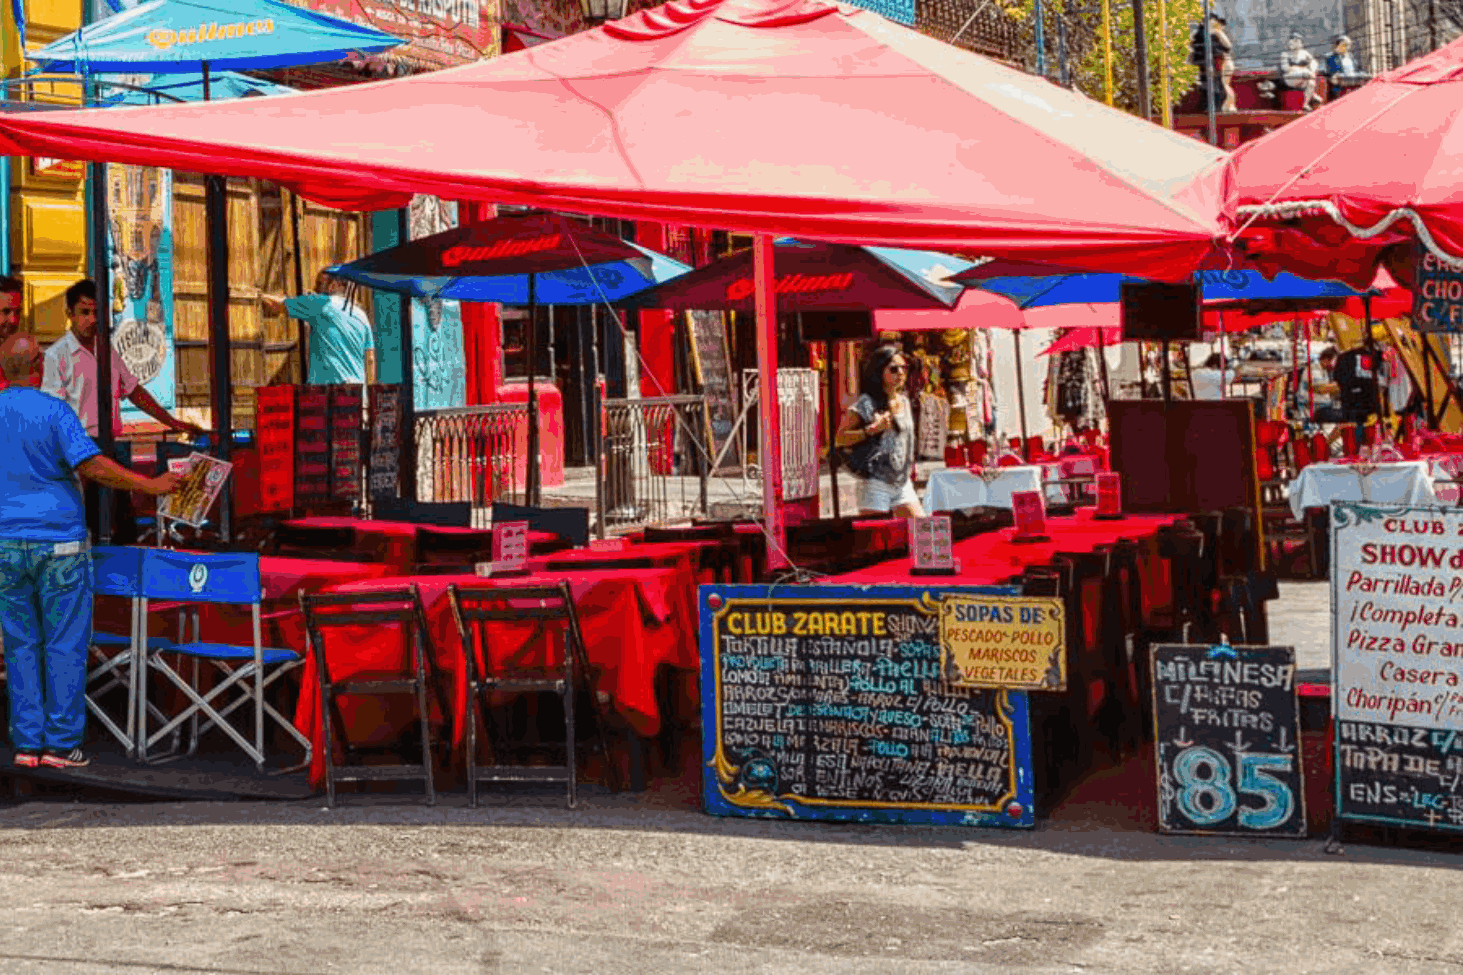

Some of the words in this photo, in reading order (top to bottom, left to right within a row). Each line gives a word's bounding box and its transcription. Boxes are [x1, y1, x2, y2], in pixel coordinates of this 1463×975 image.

[1384, 518, 1445, 535] CLUB
[1361, 543, 1447, 569] SHOW
[1347, 570, 1445, 597] Parrillada
[728, 612, 787, 635] CLUB
[793, 612, 887, 635] ZARATE
[955, 604, 1015, 624] SOPAS
[1019, 605, 1046, 625] DE
[1011, 629, 1055, 646] POLLO
[1348, 628, 1405, 654] Pizza
[968, 647, 1037, 665] MARISCOS
[964, 665, 1038, 682] VEGETALES
[1379, 661, 1458, 687] Casera
[1347, 687, 1432, 722] Choripán
[1173, 746, 1295, 829] 85
